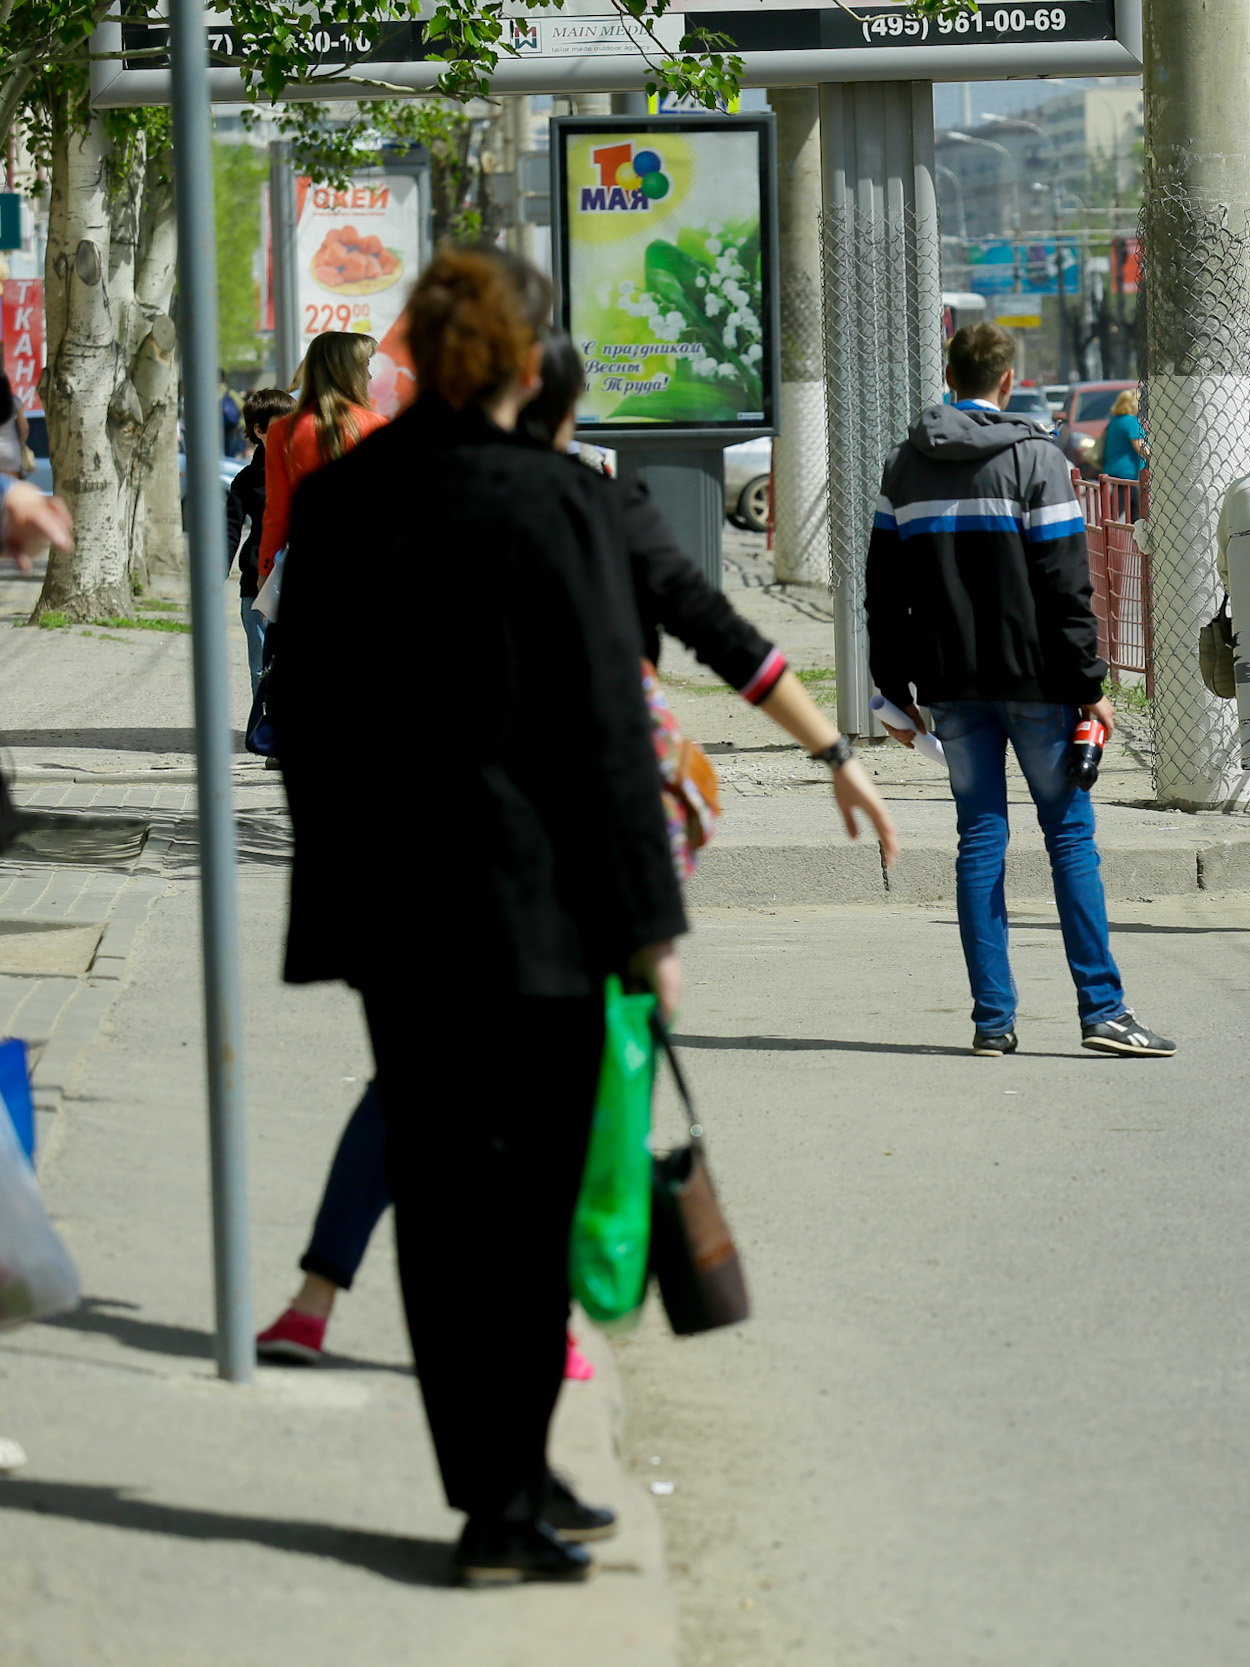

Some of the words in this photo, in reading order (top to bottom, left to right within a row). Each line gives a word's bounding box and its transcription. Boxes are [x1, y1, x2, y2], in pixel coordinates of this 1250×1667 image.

[937, 8, 1066, 33] 961-00-69
[552, 26, 598, 38] MAIN
[551, 45, 569, 53] tailor
[571, 44, 592, 52] made
[594, 43, 622, 51] outdoor
[581, 187, 649, 211] МАЯ
[304, 304, 351, 333] 229
[14, 281, 36, 409] ТКАНИ
[582, 340, 596, 355] С
[603, 343, 700, 358] праздником
[585, 358, 640, 373] Весны
[600, 376, 669, 396] Труда!
